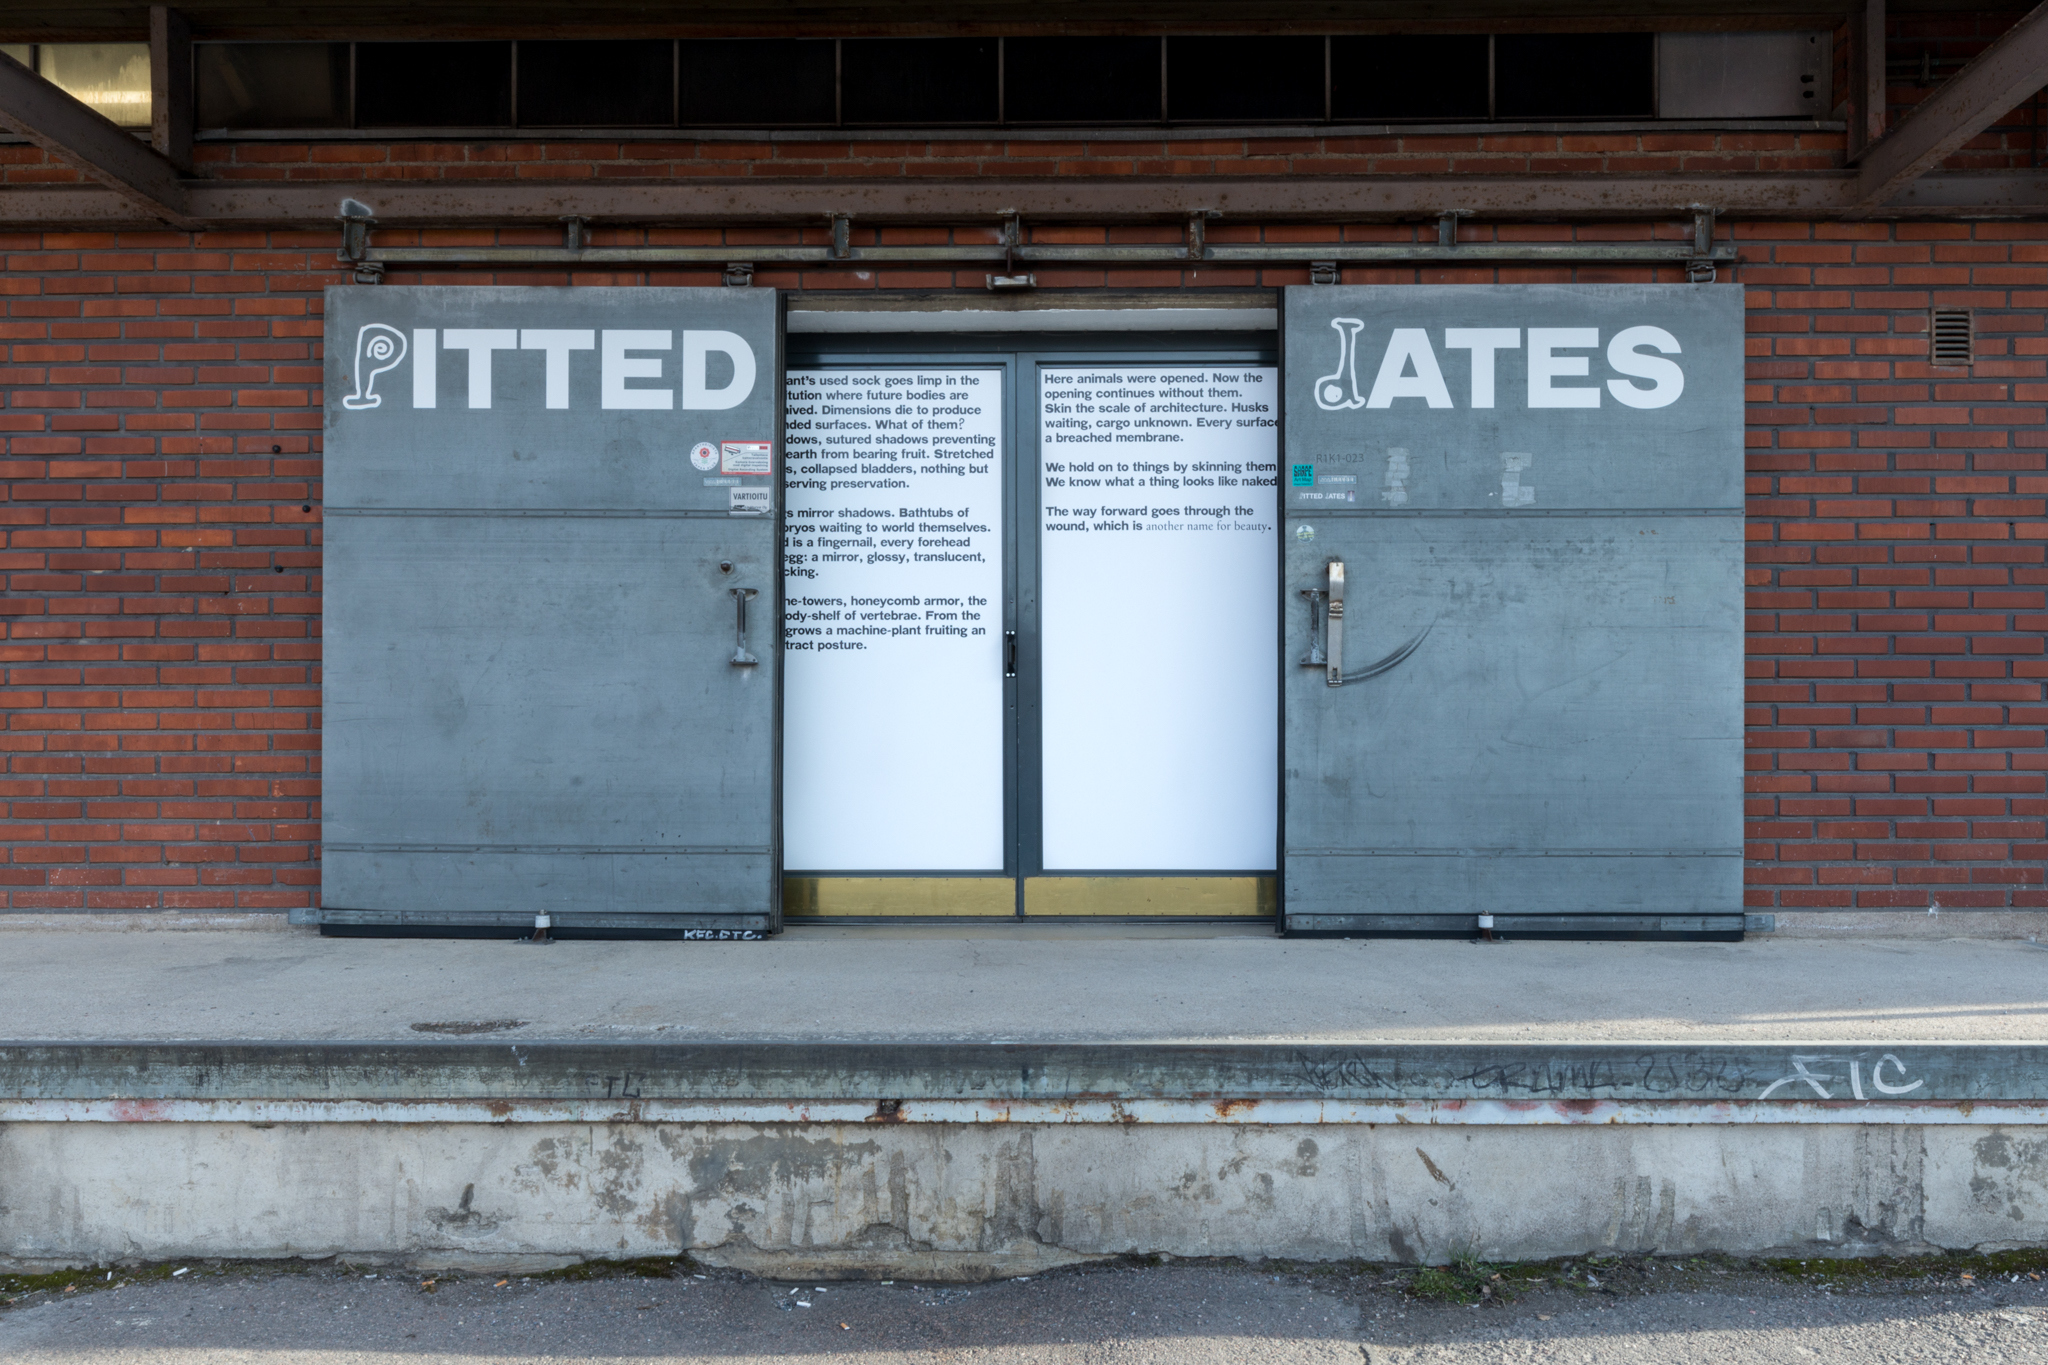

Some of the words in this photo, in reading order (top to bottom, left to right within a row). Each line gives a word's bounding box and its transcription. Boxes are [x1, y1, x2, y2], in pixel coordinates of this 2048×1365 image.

[786, 376, 816, 386] ant's
[820, 375, 848, 385] used
[852, 375, 881, 385] sock
[885, 378, 913, 388] goes
[918, 375, 942, 387] limp
[946, 375, 956, 385] in
[960, 375, 980, 385] the
[1045, 374, 1073, 384] Here
[1077, 374, 1123, 383] animals
[1160, 373, 1208, 385] opened.
[1213, 373, 1239, 382] Now
[1244, 373, 1263, 383] the
[786, 390, 822, 400] tution
[826, 390, 863, 400] where
[867, 390, 902, 400] future
[907, 390, 946, 400] bodies
[1045, 389, 1092, 401] opening
[1096, 388, 1155, 398] continues
[1159, 388, 1204, 398] without
[1208, 388, 1242, 397] them.
[822, 405, 891, 415] Dimensions
[895, 405, 913, 415] die
[917, 406, 929, 415] to
[933, 405, 981, 417] produce
[1045, 403, 1072, 413] Skin
[1076, 403, 1095, 413] the
[1099, 403, 1130, 413] scale
[1134, 403, 1146, 412] of
[1150, 402, 1227, 412] architecture.
[1232, 402, 1269, 412] Husks
[815, 420, 871, 429] surfaces.
[875, 420, 907, 429] What
[912, 419, 923, 429] of
[928, 419, 965, 429] them?
[1045, 418, 1092, 430] waiting,
[1096, 420, 1130, 430] cargo
[1134, 417, 1192, 427] unknown.
[1197, 418, 1232, 429] Every
[786, 434, 822, 446] dows,
[826, 434, 871, 444] sutured
[876, 434, 928, 444] shadows
[933, 434, 996, 447] preventing
[1056, 432, 1112, 443] breached
[1116, 432, 1183, 442] membrane.
[786, 449, 817, 459] earth
[821, 449, 849, 459] from
[853, 449, 897, 461] bearing
[902, 449, 930, 459] fruit.
[934, 449, 994, 459] Stretched
[1316, 453, 1364, 463] R1K1-023
[801, 464, 857, 476] collapsed
[862, 464, 917, 475] bladders,
[921, 464, 965, 476] nothing
[970, 464, 988, 474] but
[1046, 463, 1065, 472] We
[1070, 462, 1094, 472] hold
[1098, 464, 1113, 472] on
[1117, 462, 1129, 472] to
[1133, 462, 1170, 474] things
[1174, 462, 1188, 474] by
[1192, 462, 1242, 474] skinning
[785, 478, 827, 491] serving
[831, 478, 909, 490] preservation.
[1046, 478, 1065, 487] We
[1070, 477, 1101, 486] know
[1105, 477, 1134, 486] what
[1150, 476, 1179, 489] thing
[1184, 476, 1214, 486] looks
[1219, 476, 1238, 486] like
[1242, 476, 1278, 486] naked
[733, 492, 768, 500] VARTIOITU
[798, 508, 834, 518] mirror
[838, 508, 895, 518] shadows.
[900, 508, 954, 518] Bathtubs
[958, 508, 969, 518] of
[1046, 507, 1069, 516] The
[1073, 509, 1097, 519] way
[1101, 506, 1147, 516] forward
[1152, 508, 1180, 518] goes
[1184, 506, 1230, 518] through
[1234, 506, 1254, 516] the
[820, 523, 862, 535] waiting
[866, 523, 878, 532] to
[882, 522, 914, 532] world
[919, 522, 991, 532] themselves.
[1046, 521, 1089, 532] wound,
[1094, 521, 1129, 530] which
[1133, 521, 1143, 530] is
[1146, 521, 1183, 530] another
[1217, 520, 1231, 530] for
[1235, 521, 1271, 533] beauty.
[793, 537, 803, 547] is
[818, 537, 876, 550] fingernail,
[881, 540, 914, 549] every
[918, 537, 970, 547] forehead
[812, 554, 818, 562] a
[822, 552, 863, 563] mirror,
[867, 552, 909, 564] glossy,
[914, 552, 985, 563] translucent,
[785, 566, 819, 579] cking.
[785, 596, 847, 607] ne-towers,
[851, 596, 920, 608] honeycomb
[924, 598, 964, 607] armor,
[968, 596, 987, 606] the
[785, 610, 841, 623] ody-shelf
[844, 610, 856, 620] of
[860, 610, 921, 620] vertebrae.
[926, 611, 957, 620] From
[962, 610, 981, 620] the
[785, 628, 822, 638] grows
[837, 625, 921, 637] machine-plant
[925, 625, 968, 638] fruiting
[784, 640, 814, 650] tract
[818, 640, 867, 652] posture.
